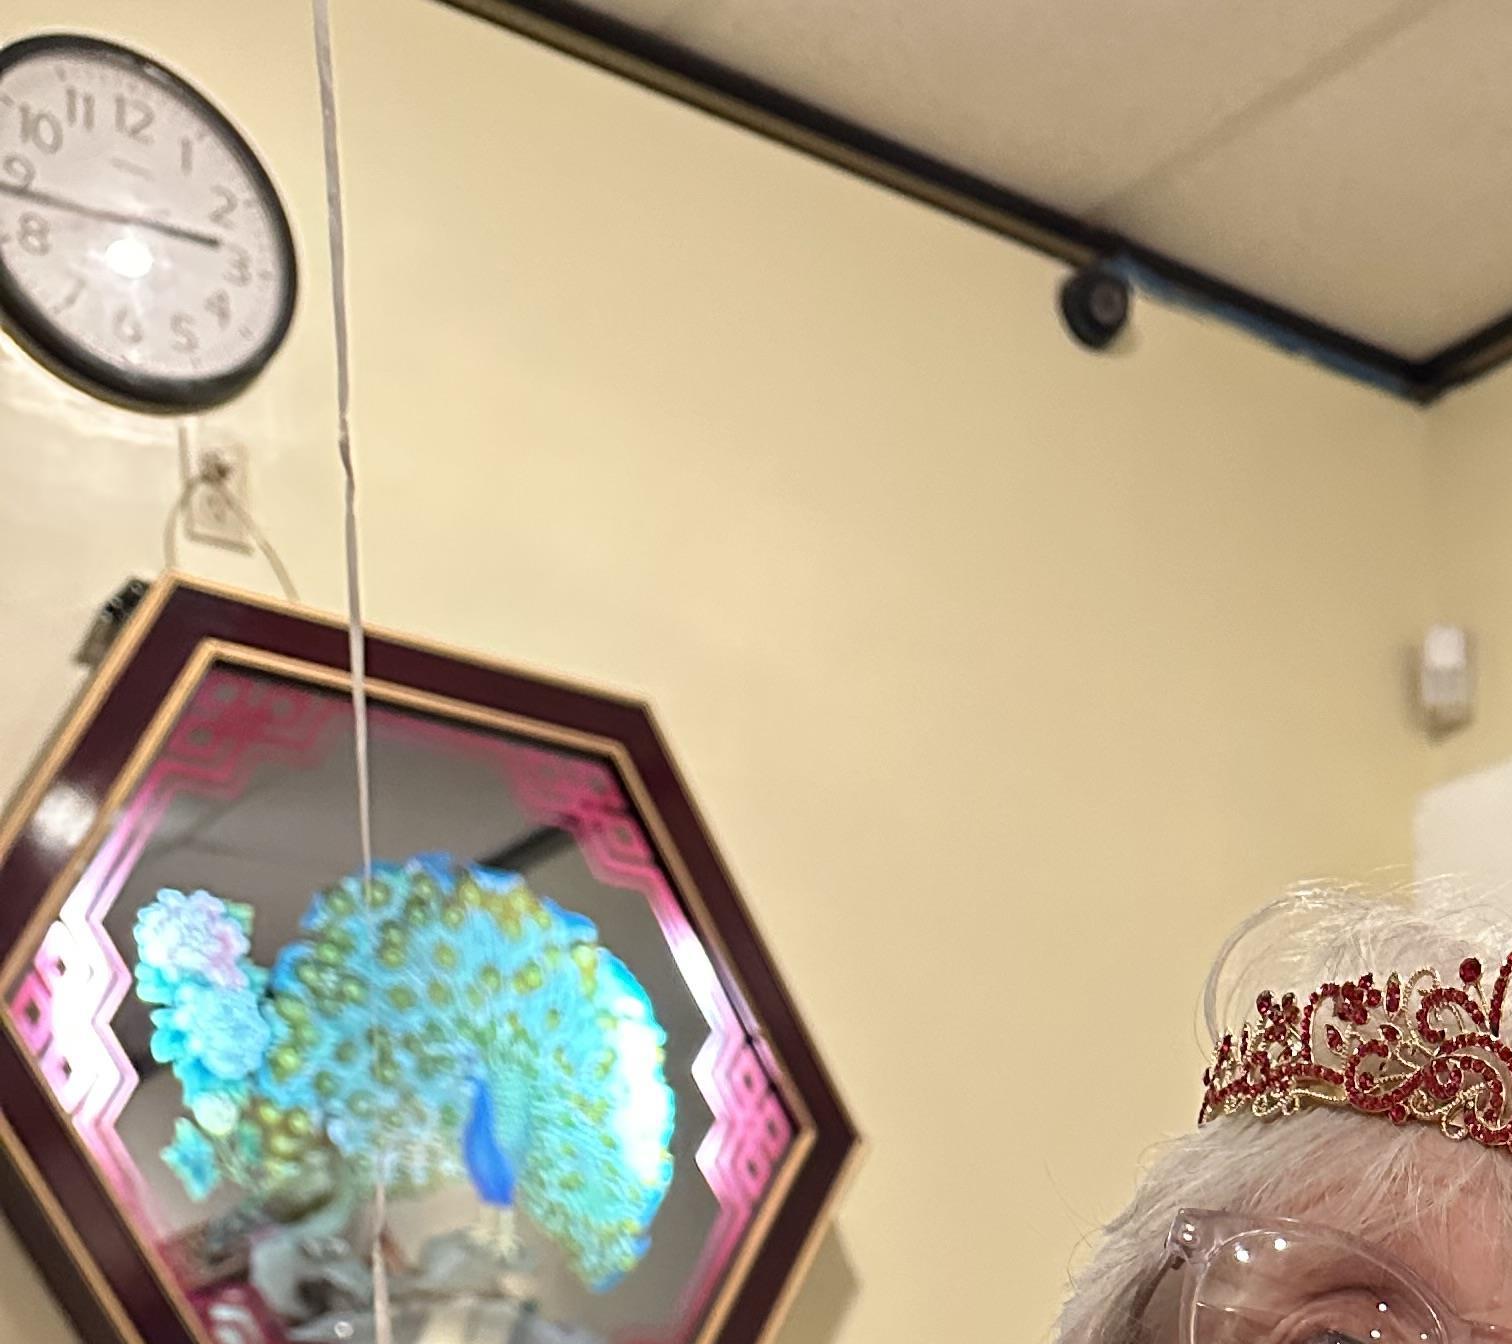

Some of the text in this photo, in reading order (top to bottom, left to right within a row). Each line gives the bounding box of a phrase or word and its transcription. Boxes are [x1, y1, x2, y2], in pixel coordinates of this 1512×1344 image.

[20, 103, 64, 155] 10
[65, 86, 95, 132] 11
[115, 94, 155, 145] 12
[4, 152, 36, 192] 9
[180, 136, 193, 173] 1
[208, 184, 239, 229] 2
[18, 211, 51, 256] 8
[224, 243, 253, 287] 3
[112, 307, 145, 345] 6
[204, 288, 232, 331] 4
[169, 311, 200, 353] 5
